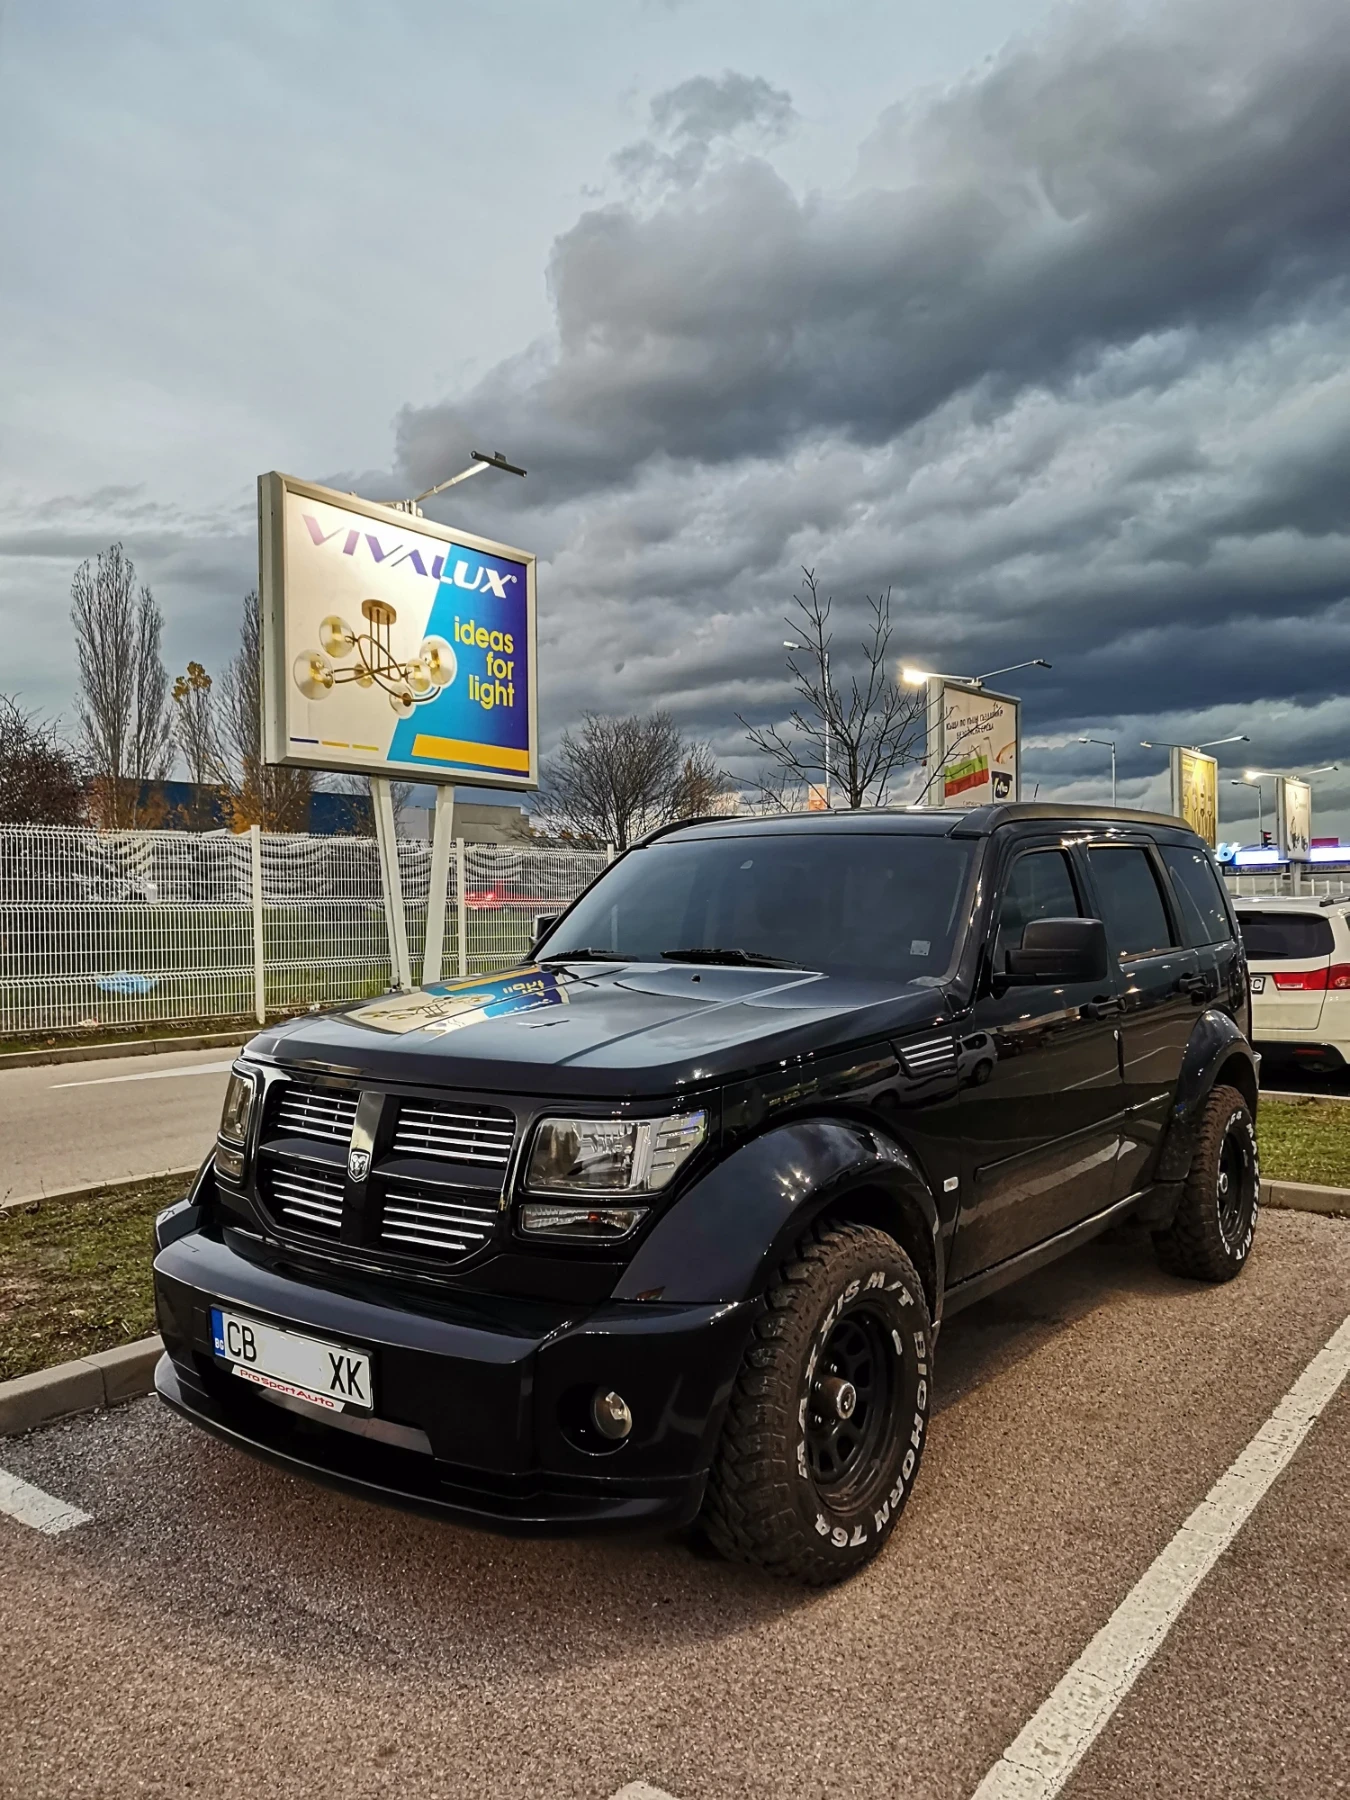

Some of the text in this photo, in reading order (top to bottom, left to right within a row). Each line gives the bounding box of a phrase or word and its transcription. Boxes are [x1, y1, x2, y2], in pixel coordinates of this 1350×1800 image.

[303, 514, 512, 598] VIVALUX
[454, 616, 514, 654] ideas
[486, 652, 514, 680] for
[469, 674, 514, 709] light
[863, 1271, 914, 1307] M/T
[215, 1321, 365, 1400] BG CB XK
[797, 1279, 860, 1479] MAXXIS
[874, 1331, 927, 1532] BIGHORN
[815, 1513, 868, 1547] 764
